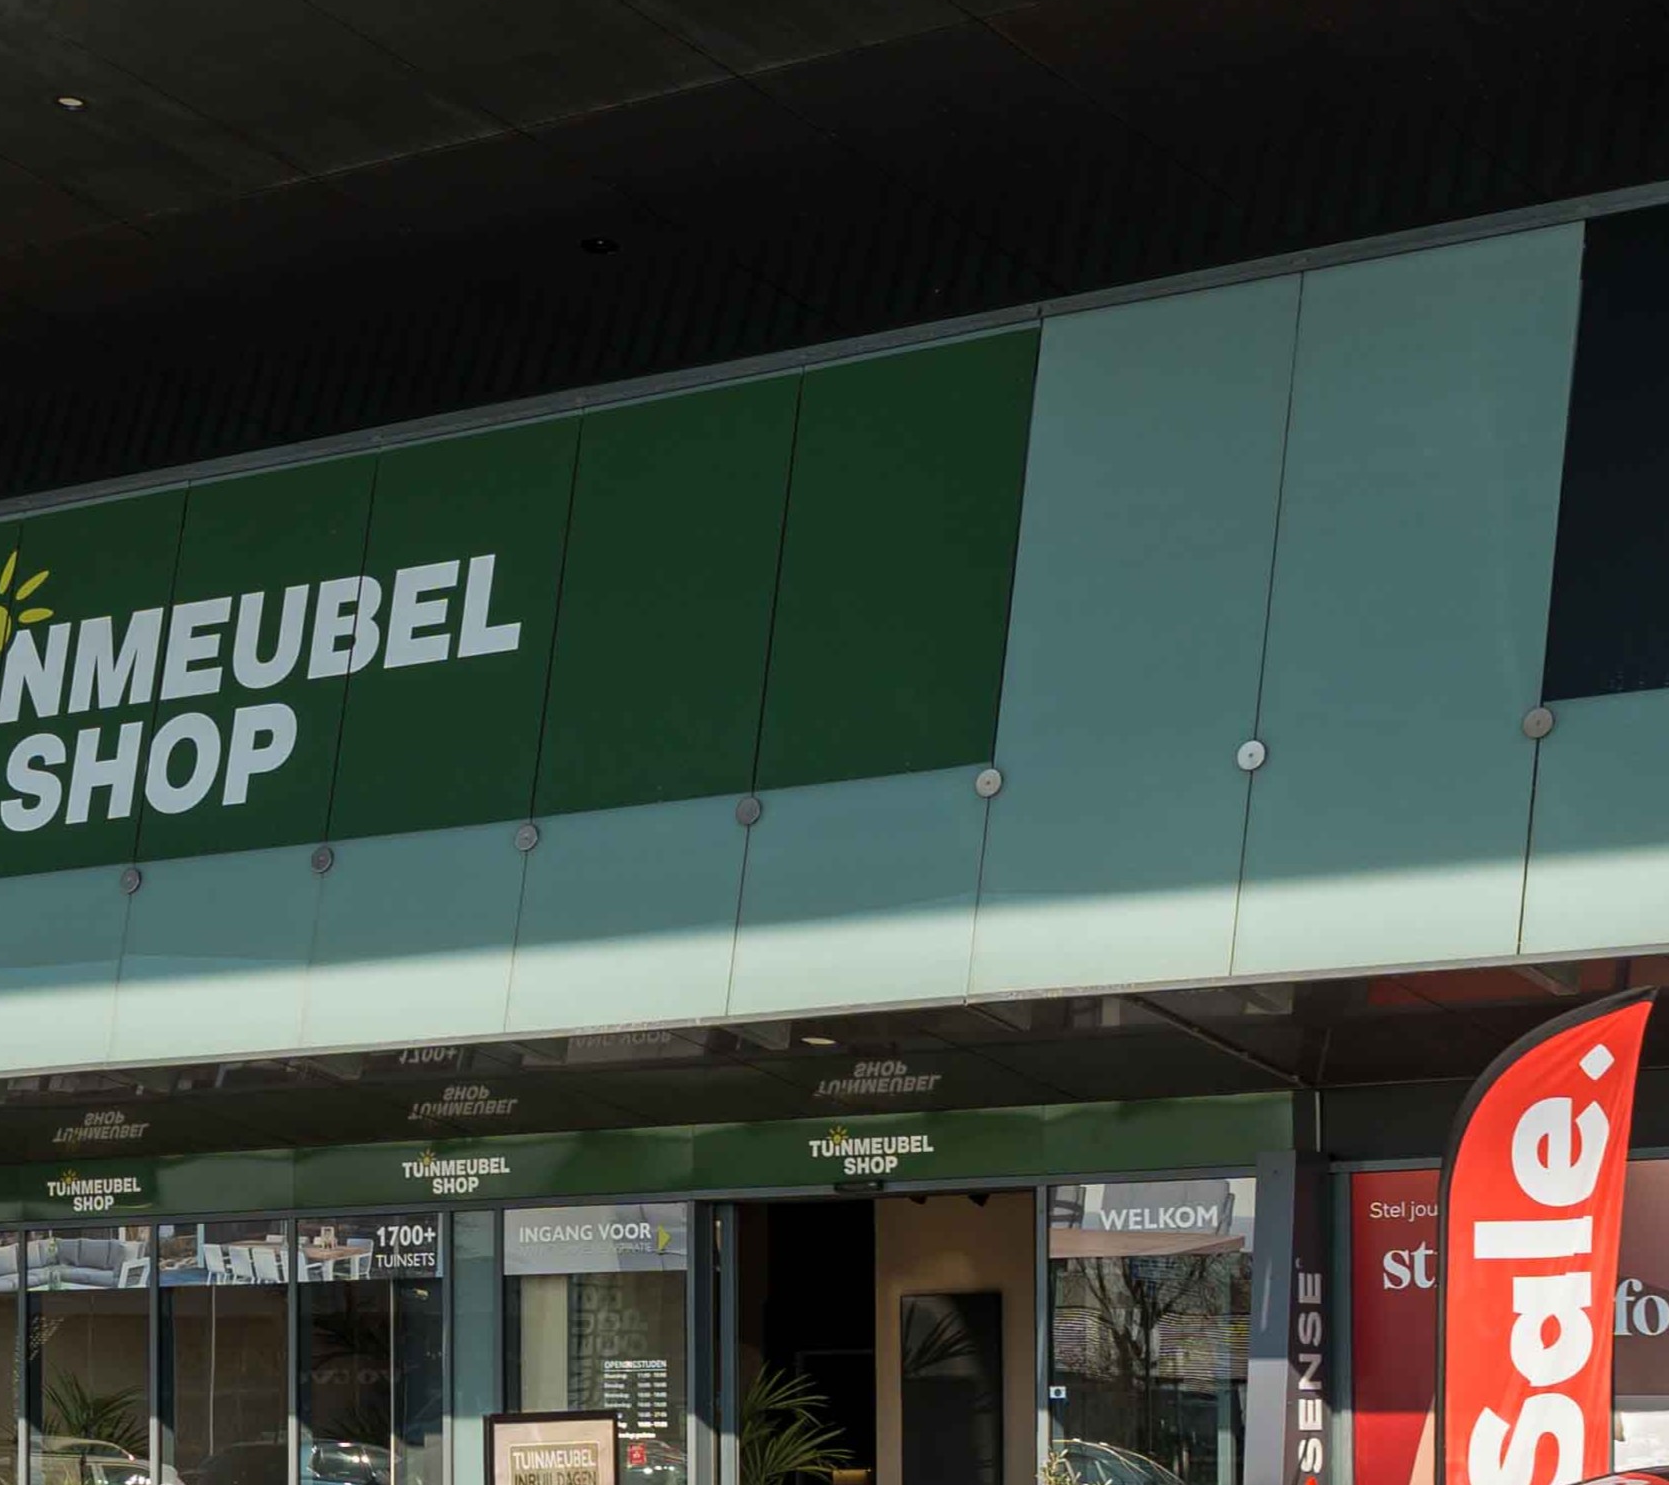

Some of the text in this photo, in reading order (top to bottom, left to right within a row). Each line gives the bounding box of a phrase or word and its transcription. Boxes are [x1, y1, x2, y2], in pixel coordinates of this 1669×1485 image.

[0, 703, 298, 833] SHOP
[844, 1156, 898, 1175] SHOP
[432, 1177, 479, 1194] SHOP
[73, 1196, 114, 1212] SHOP
[1370, 1201, 1438, 1223] Stel jou
[1099, 1204, 1219, 1231] WELKOM
[376, 1225, 436, 1248] 1700+
[519, 1222, 652, 1244] INGANG VOOR
[375, 1251, 436, 1269] TUINSETS
[1383, 1241, 1437, 1290] st
[512, 1448, 597, 1470] TUINMEUBEL
